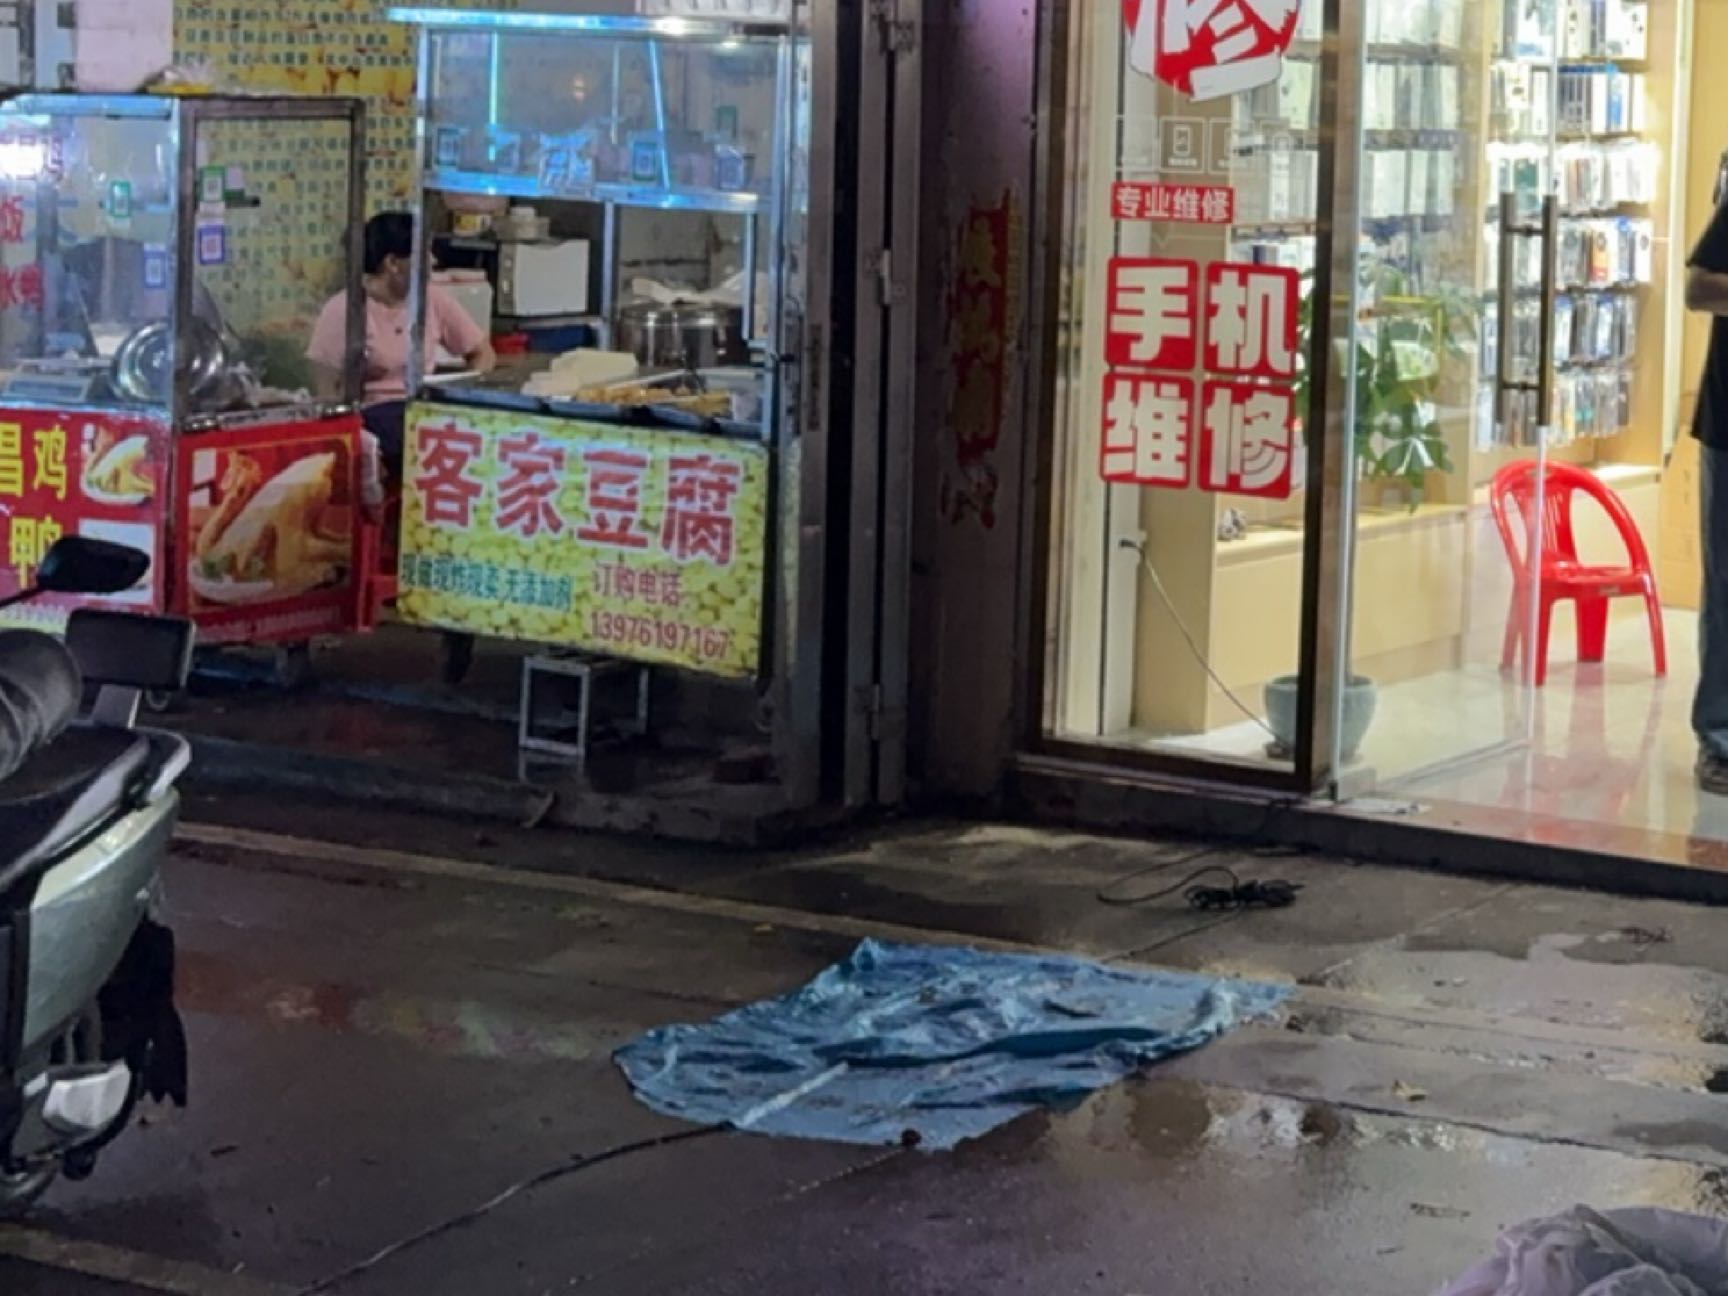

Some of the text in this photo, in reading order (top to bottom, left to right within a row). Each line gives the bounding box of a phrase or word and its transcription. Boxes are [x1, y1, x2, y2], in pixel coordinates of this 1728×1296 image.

[1116, 186, 1230, 222] 专业维修
[1107, 265, 1295, 372] 手机
[415, 418, 744, 566] 客家豆腐
[1104, 382, 1294, 495] 维修
